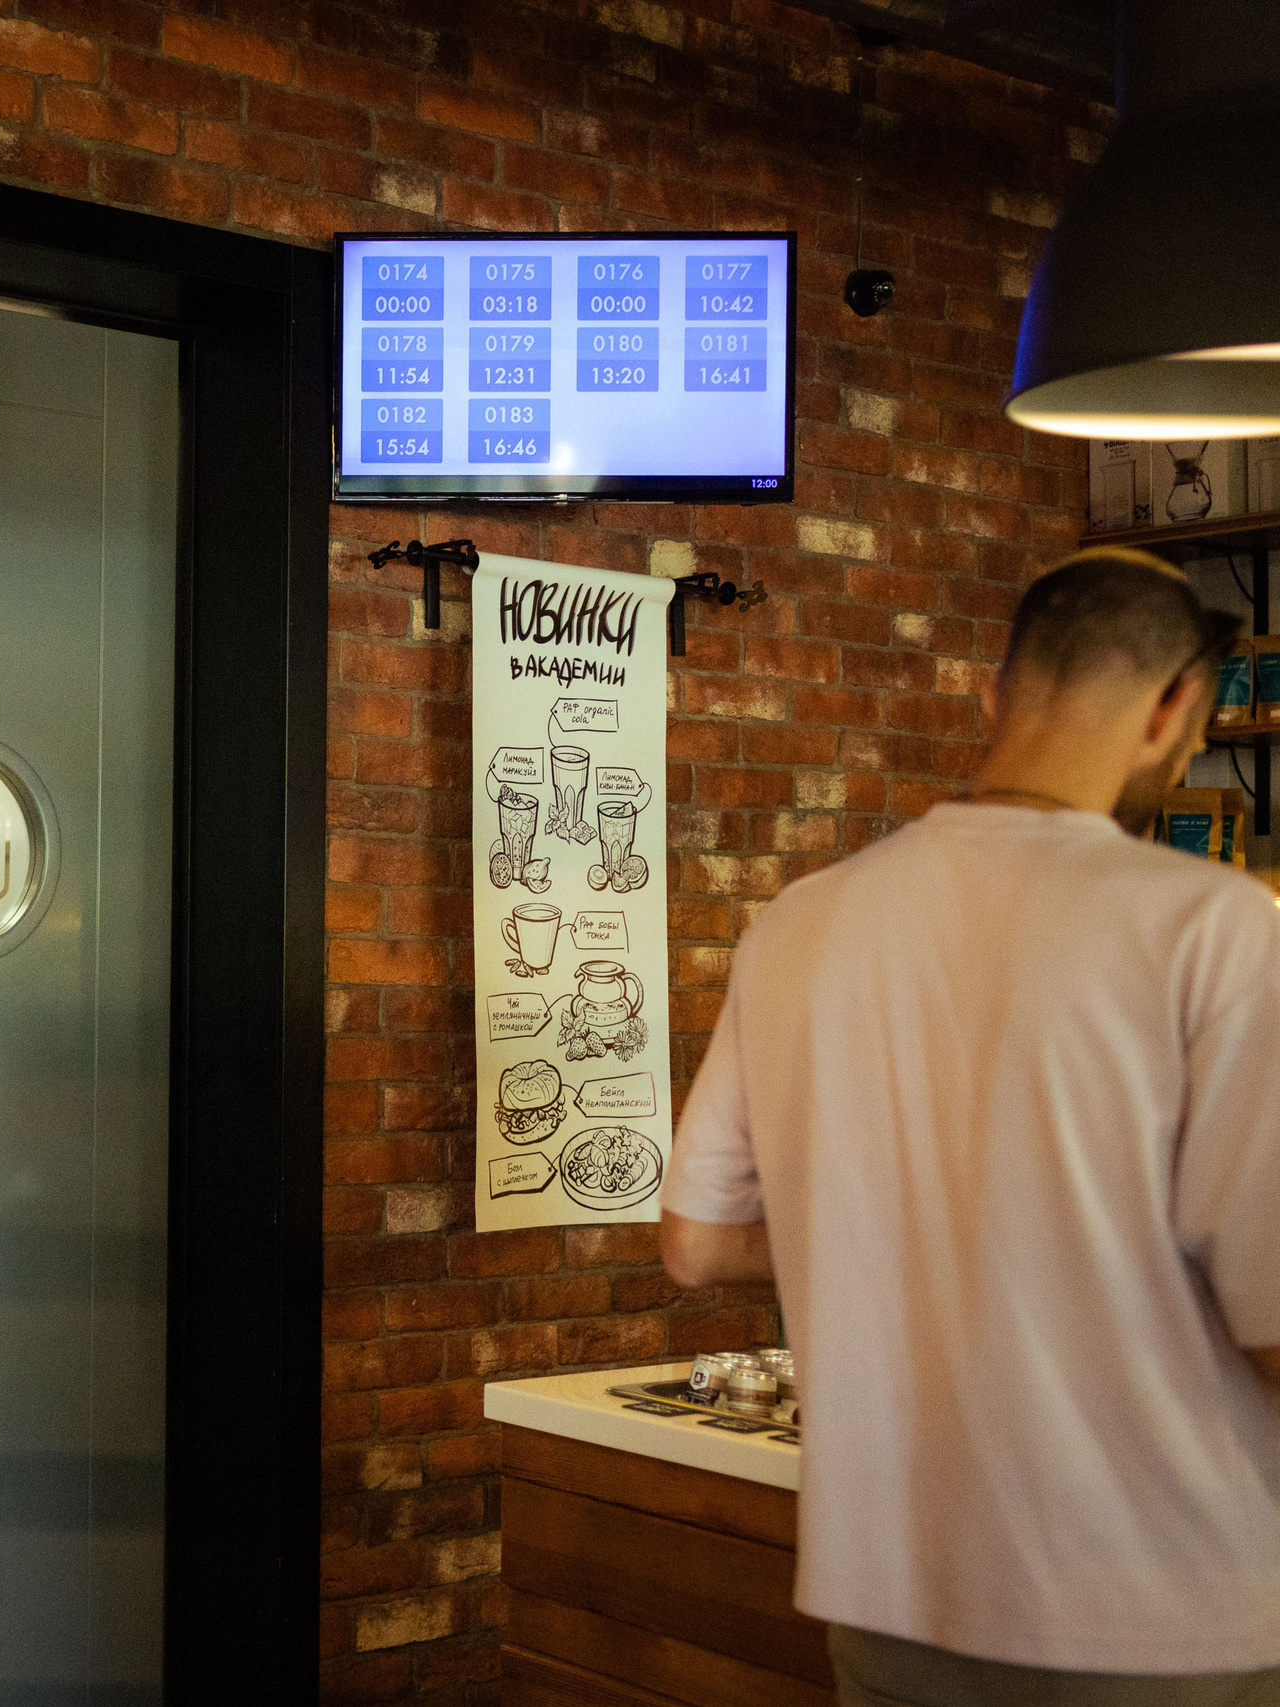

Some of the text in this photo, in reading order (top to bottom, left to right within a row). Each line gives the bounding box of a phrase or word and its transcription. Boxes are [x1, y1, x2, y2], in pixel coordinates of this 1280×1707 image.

[378, 264, 428, 281] 0174
[485, 264, 535, 281] 0175
[593, 264, 644, 281] 0176
[701, 264, 752, 281] 0177
[375, 297, 431, 313] 00:00
[483, 297, 538, 313] 03:18
[590, 297, 646, 313] 00:00
[700, 297, 754, 313] 10:42
[378, 335, 427, 352] 0178
[485, 335, 535, 352] 0179
[593, 335, 643, 352] 0180
[701, 335, 749, 352] 0181
[376, 368, 430, 385] 11:54
[484, 368, 535, 385] 12:31
[591, 368, 645, 385] 13:20
[699, 368, 751, 385] 16:41
[377, 406, 426, 423] 0182
[484, 406, 534, 423] 0183
[376, 439, 429, 456] 15:54
[483, 439, 537, 456] 16:46
[751, 478, 778, 489] 12:00
[500, 576, 644, 656] НОВИНКИ
[572, 714, 589, 724] cola
[584, 706, 614, 719] organic
[600, 1085, 625, 1097] Бейгл
